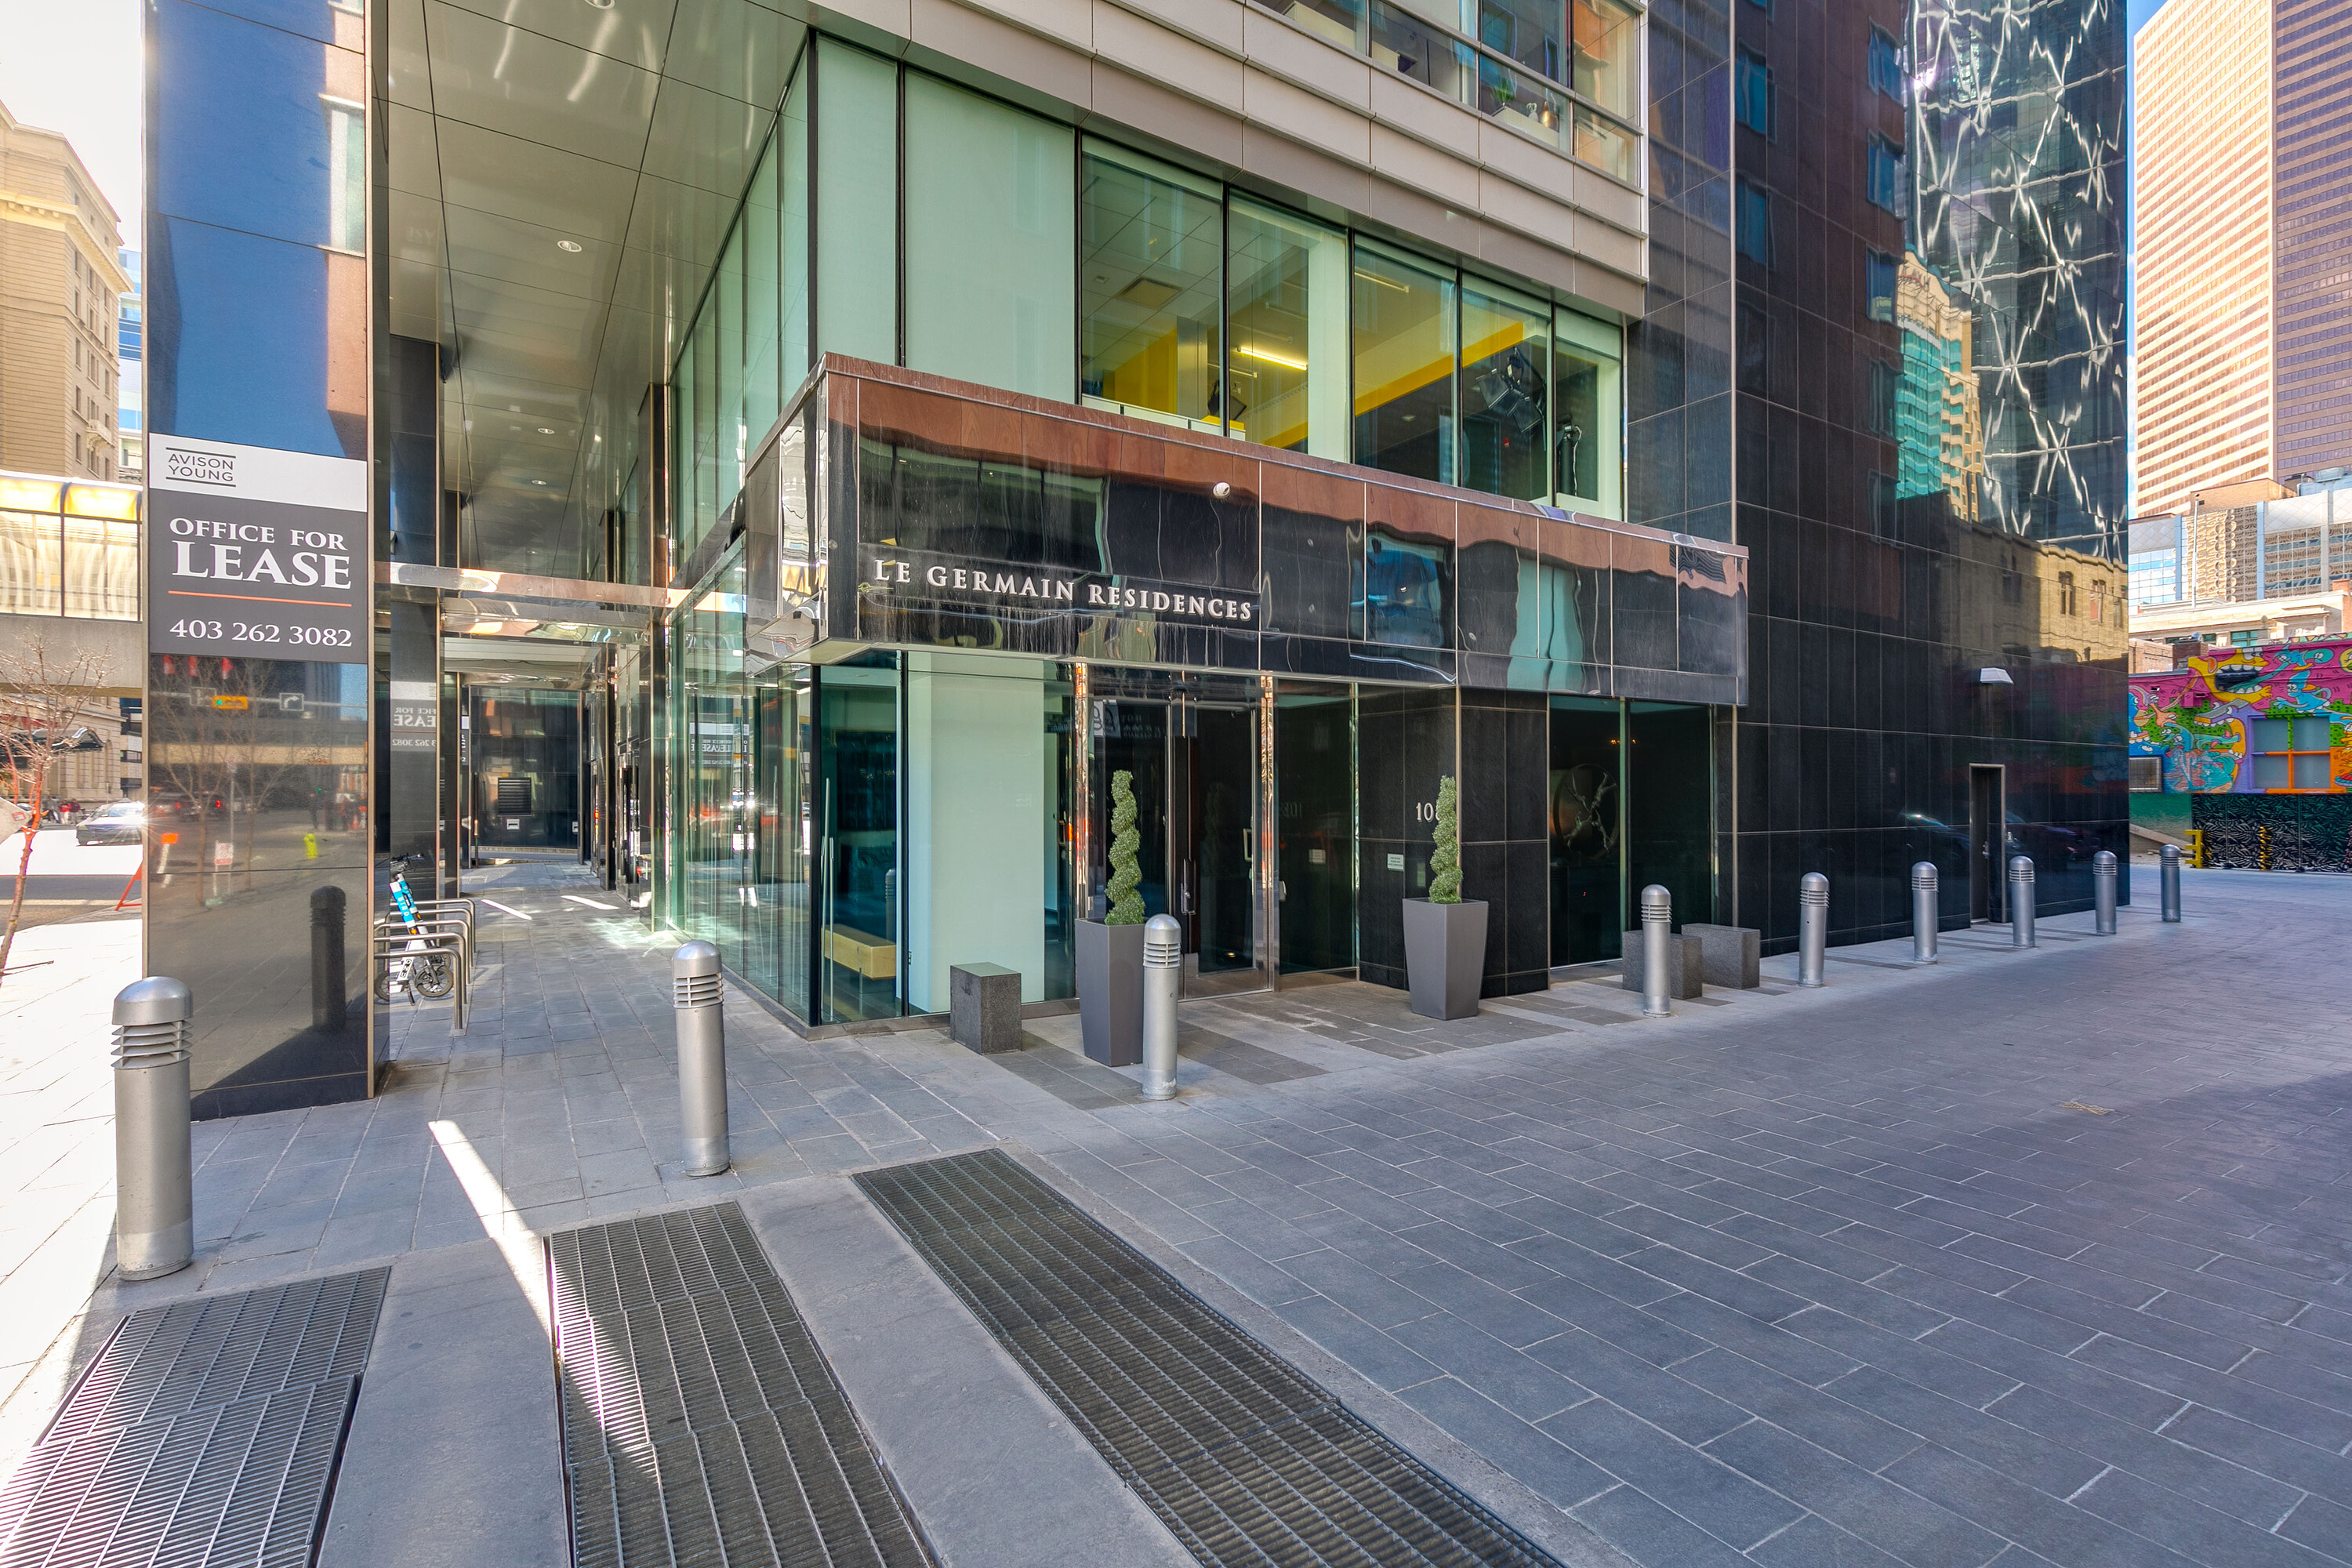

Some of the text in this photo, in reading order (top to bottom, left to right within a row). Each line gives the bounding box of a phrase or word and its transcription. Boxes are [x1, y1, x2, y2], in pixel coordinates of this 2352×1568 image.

[169, 453, 234, 470] AVISON
[169, 465, 234, 481] YOUNG
[169, 517, 348, 550] OFFICE FOR
[172, 540, 351, 589] LEASE
[874, 559, 1251, 621] LE GERMAIN RESIDENCES
[169, 619, 353, 647] 403 262 3082
[397, 896, 410, 916] BIRD
